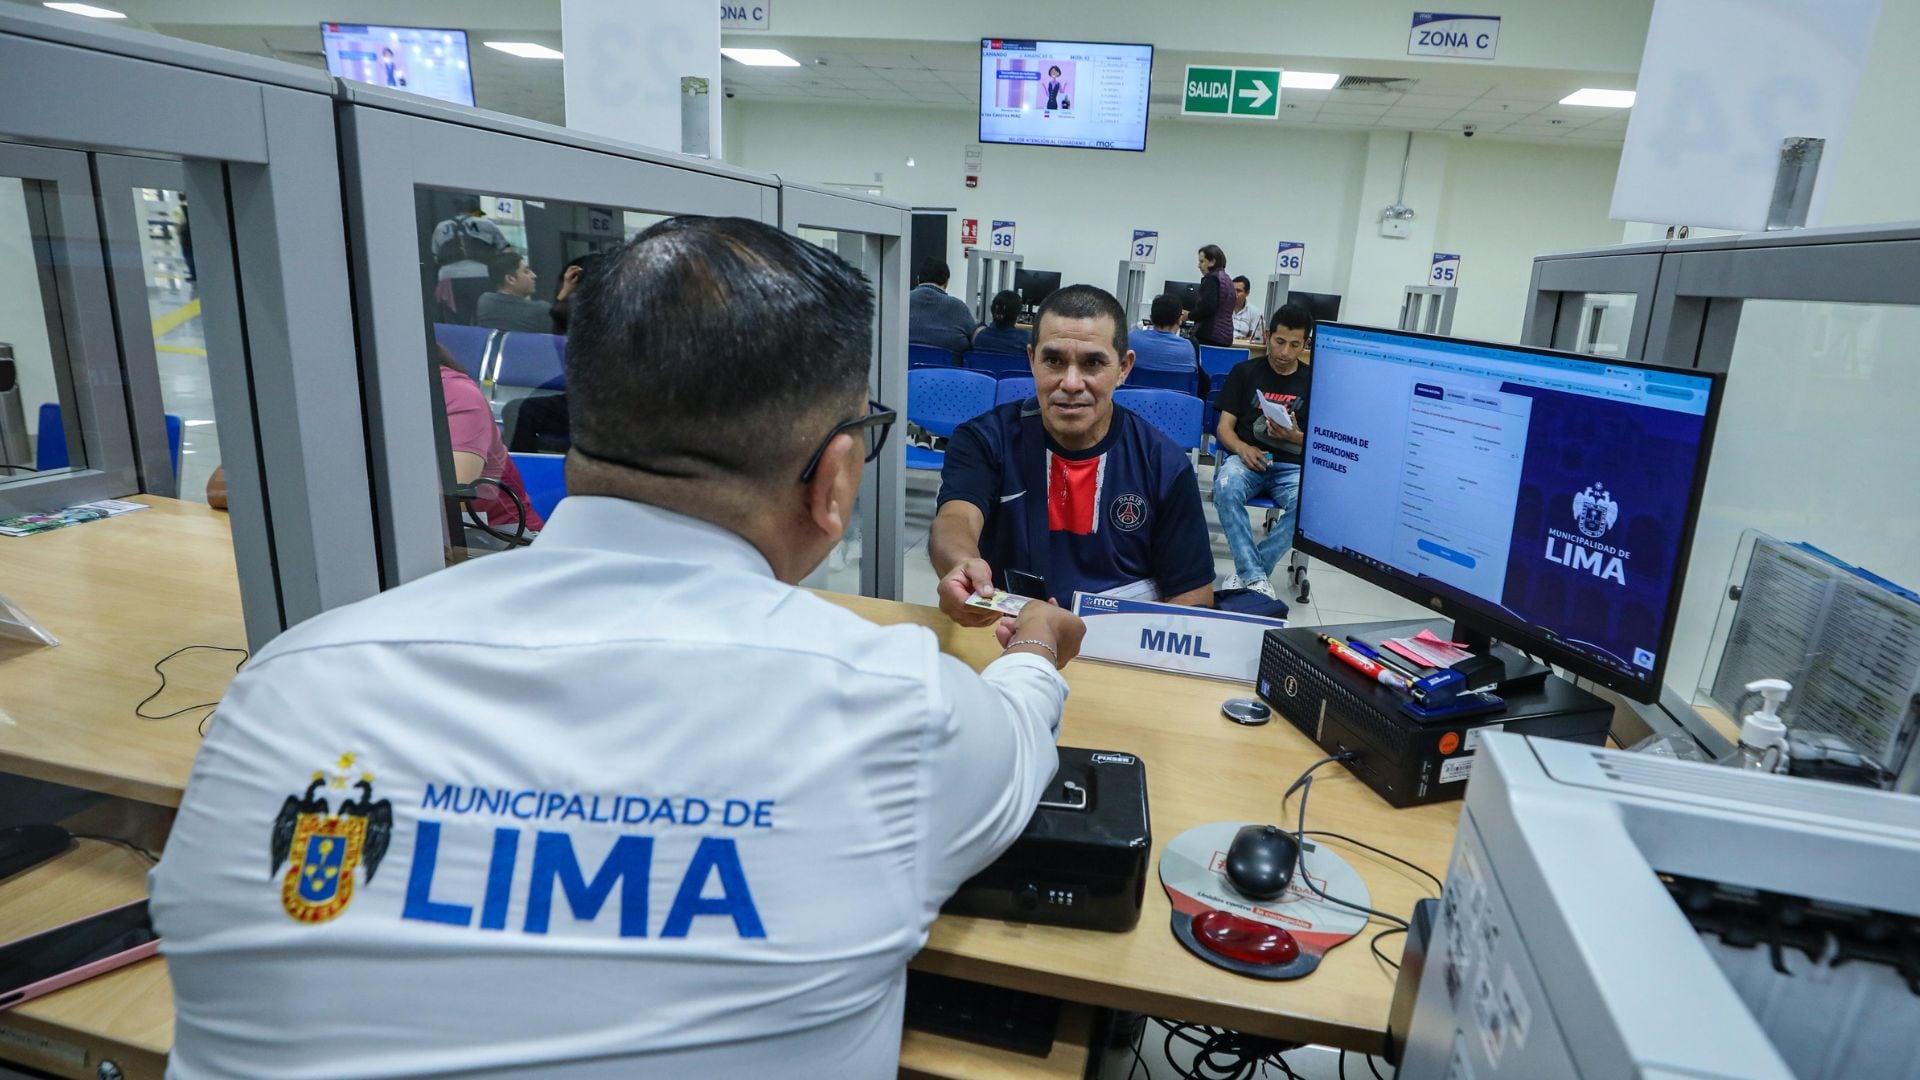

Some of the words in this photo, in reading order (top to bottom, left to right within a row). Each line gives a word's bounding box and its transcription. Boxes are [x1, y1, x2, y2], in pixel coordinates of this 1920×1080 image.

[721, 6, 747, 20] ONA
[752, 7, 763, 21] C
[1418, 30, 1469, 48] ZONA
[1476, 34, 1489, 49] C
[1188, 81, 1228, 99] SALIDA
[498, 202, 512, 213] 42
[994, 234, 1012, 247] 38
[1135, 243, 1153, 257] 37
[1280, 255, 1299, 269] 36
[1433, 267, 1455, 281] 35
[1314, 426, 1358, 446] PLATAFORMA
[1358, 438, 1369, 449] DE
[1312, 441, 1359, 462] OPERACIONES
[1311, 455, 1347, 474] VIRTUALES
[1119, 496, 1143, 506] PARIS
[1548, 527, 1617, 555] MUNICIPALIDAD
[1617, 549, 1632, 560] DE
[1544, 536, 1627, 586] LIMA
[1094, 597, 1119, 608] mac
[1139, 628, 1210, 659] MML
[421, 783, 710, 827] MUNICIPALIDAD
[723, 800, 775, 829] DE
[401, 820, 768, 940] LIMA
[1225, 900, 1252, 911] contra
